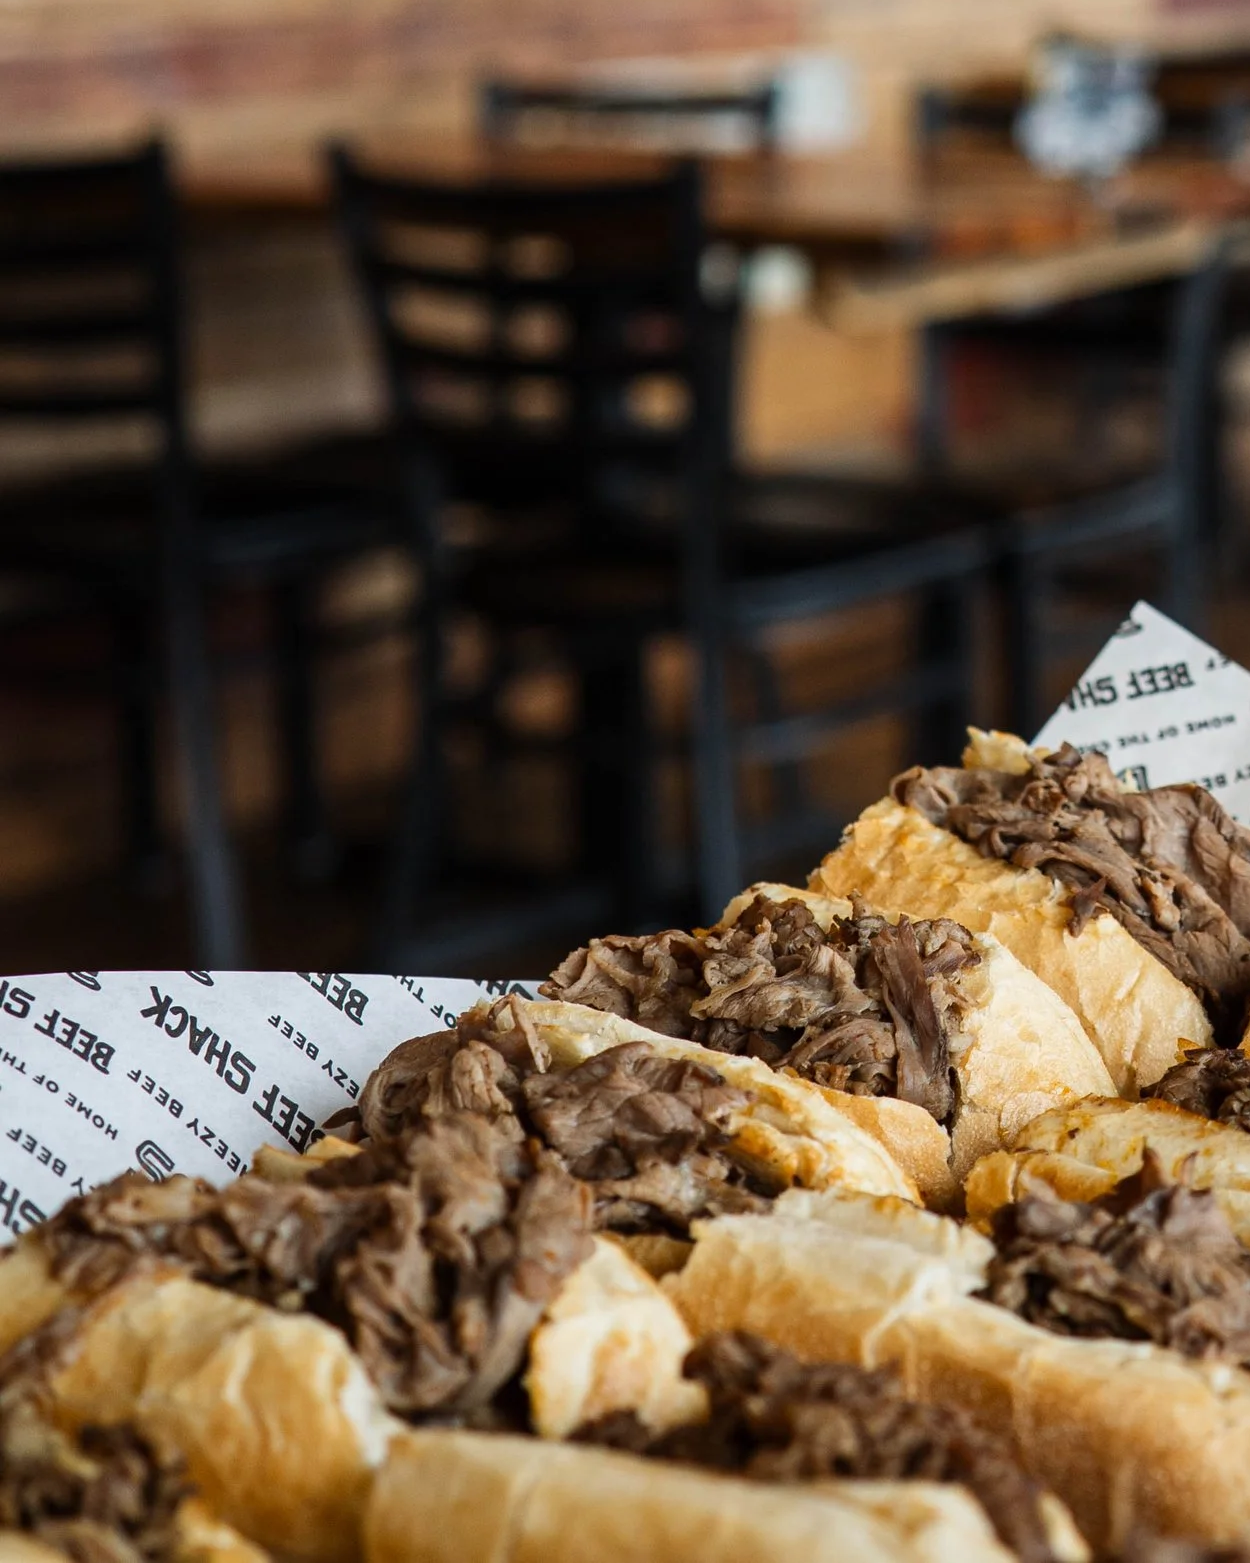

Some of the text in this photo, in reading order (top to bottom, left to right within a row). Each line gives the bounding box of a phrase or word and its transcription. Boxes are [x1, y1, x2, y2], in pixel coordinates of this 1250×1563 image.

[1127, 661, 1196, 700] BEEF
[1118, 732, 1149, 749] THE
[1157, 724, 1179, 741] OF
[1186, 713, 1236, 734] HOME
[267, 1014, 320, 1061] BEEF
[430, 1004, 457, 1028] OF
[33, 1008, 116, 1075] BEEF
[139, 985, 257, 1095] SHACK
[32, 1074, 60, 1094] OF
[126, 1069, 184, 1119] BEEF
[64, 1091, 119, 1140] HOME
[5, 1127, 68, 1178] BEEF
